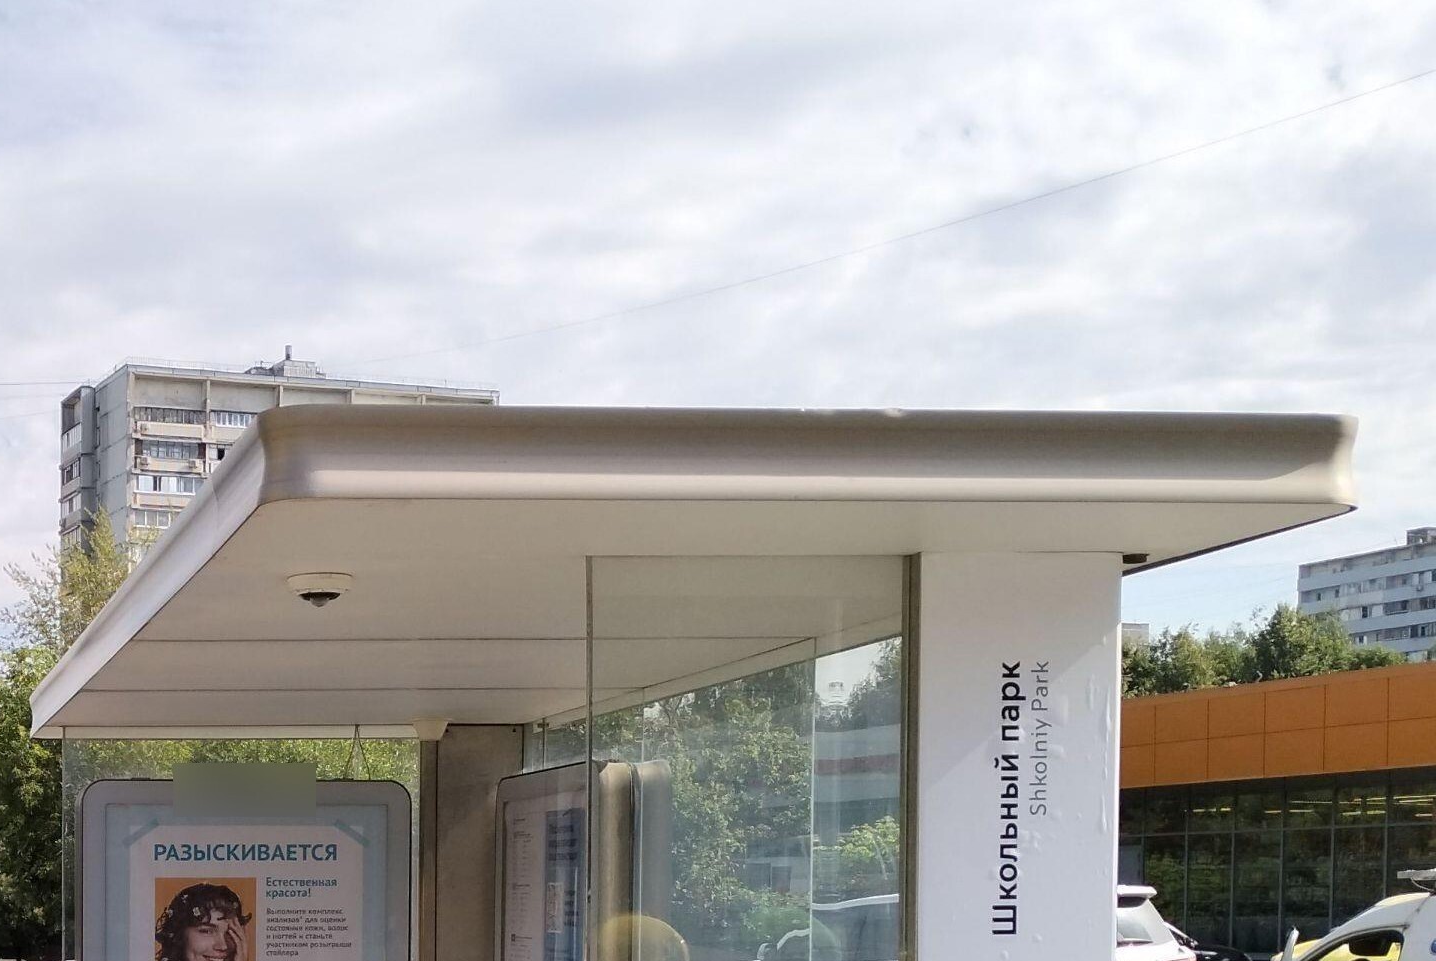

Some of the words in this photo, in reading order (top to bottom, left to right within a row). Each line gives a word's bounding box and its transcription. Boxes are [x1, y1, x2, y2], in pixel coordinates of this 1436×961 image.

[1001, 661, 1026, 742] парк
[1031, 660, 1050, 711] Park
[1029, 718, 1052, 816] Shkolniy
[154, 844, 337, 861] РАЗЫСКИВАЕТСЯ
[992, 753, 1019, 935] Школьный
[266, 877, 337, 887] Естественная
[266, 888, 311, 898] красота!
